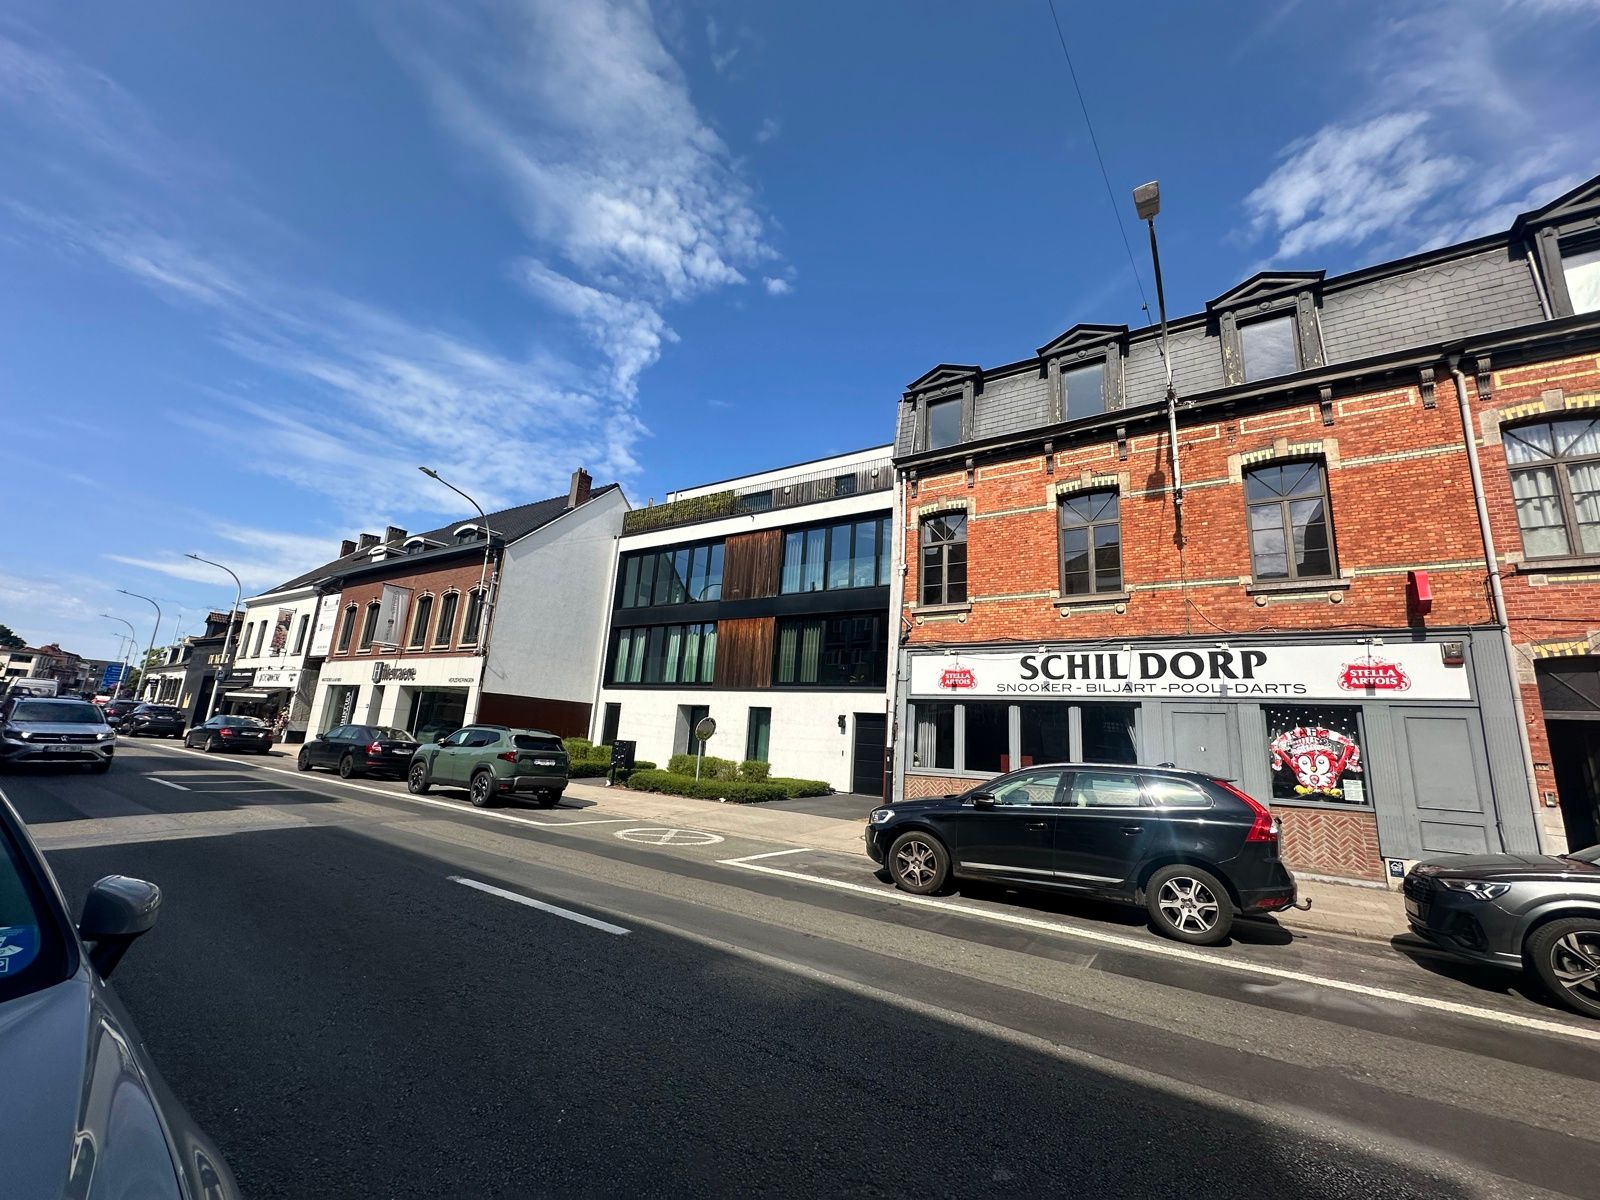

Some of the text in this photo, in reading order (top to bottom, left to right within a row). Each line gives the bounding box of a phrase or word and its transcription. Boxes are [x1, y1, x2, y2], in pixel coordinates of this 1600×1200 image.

[1350, 669, 1396, 677] STELLA
[1350, 677, 1398, 685] ARTOIS
[997, 683, 1070, 692] SNOOKER
